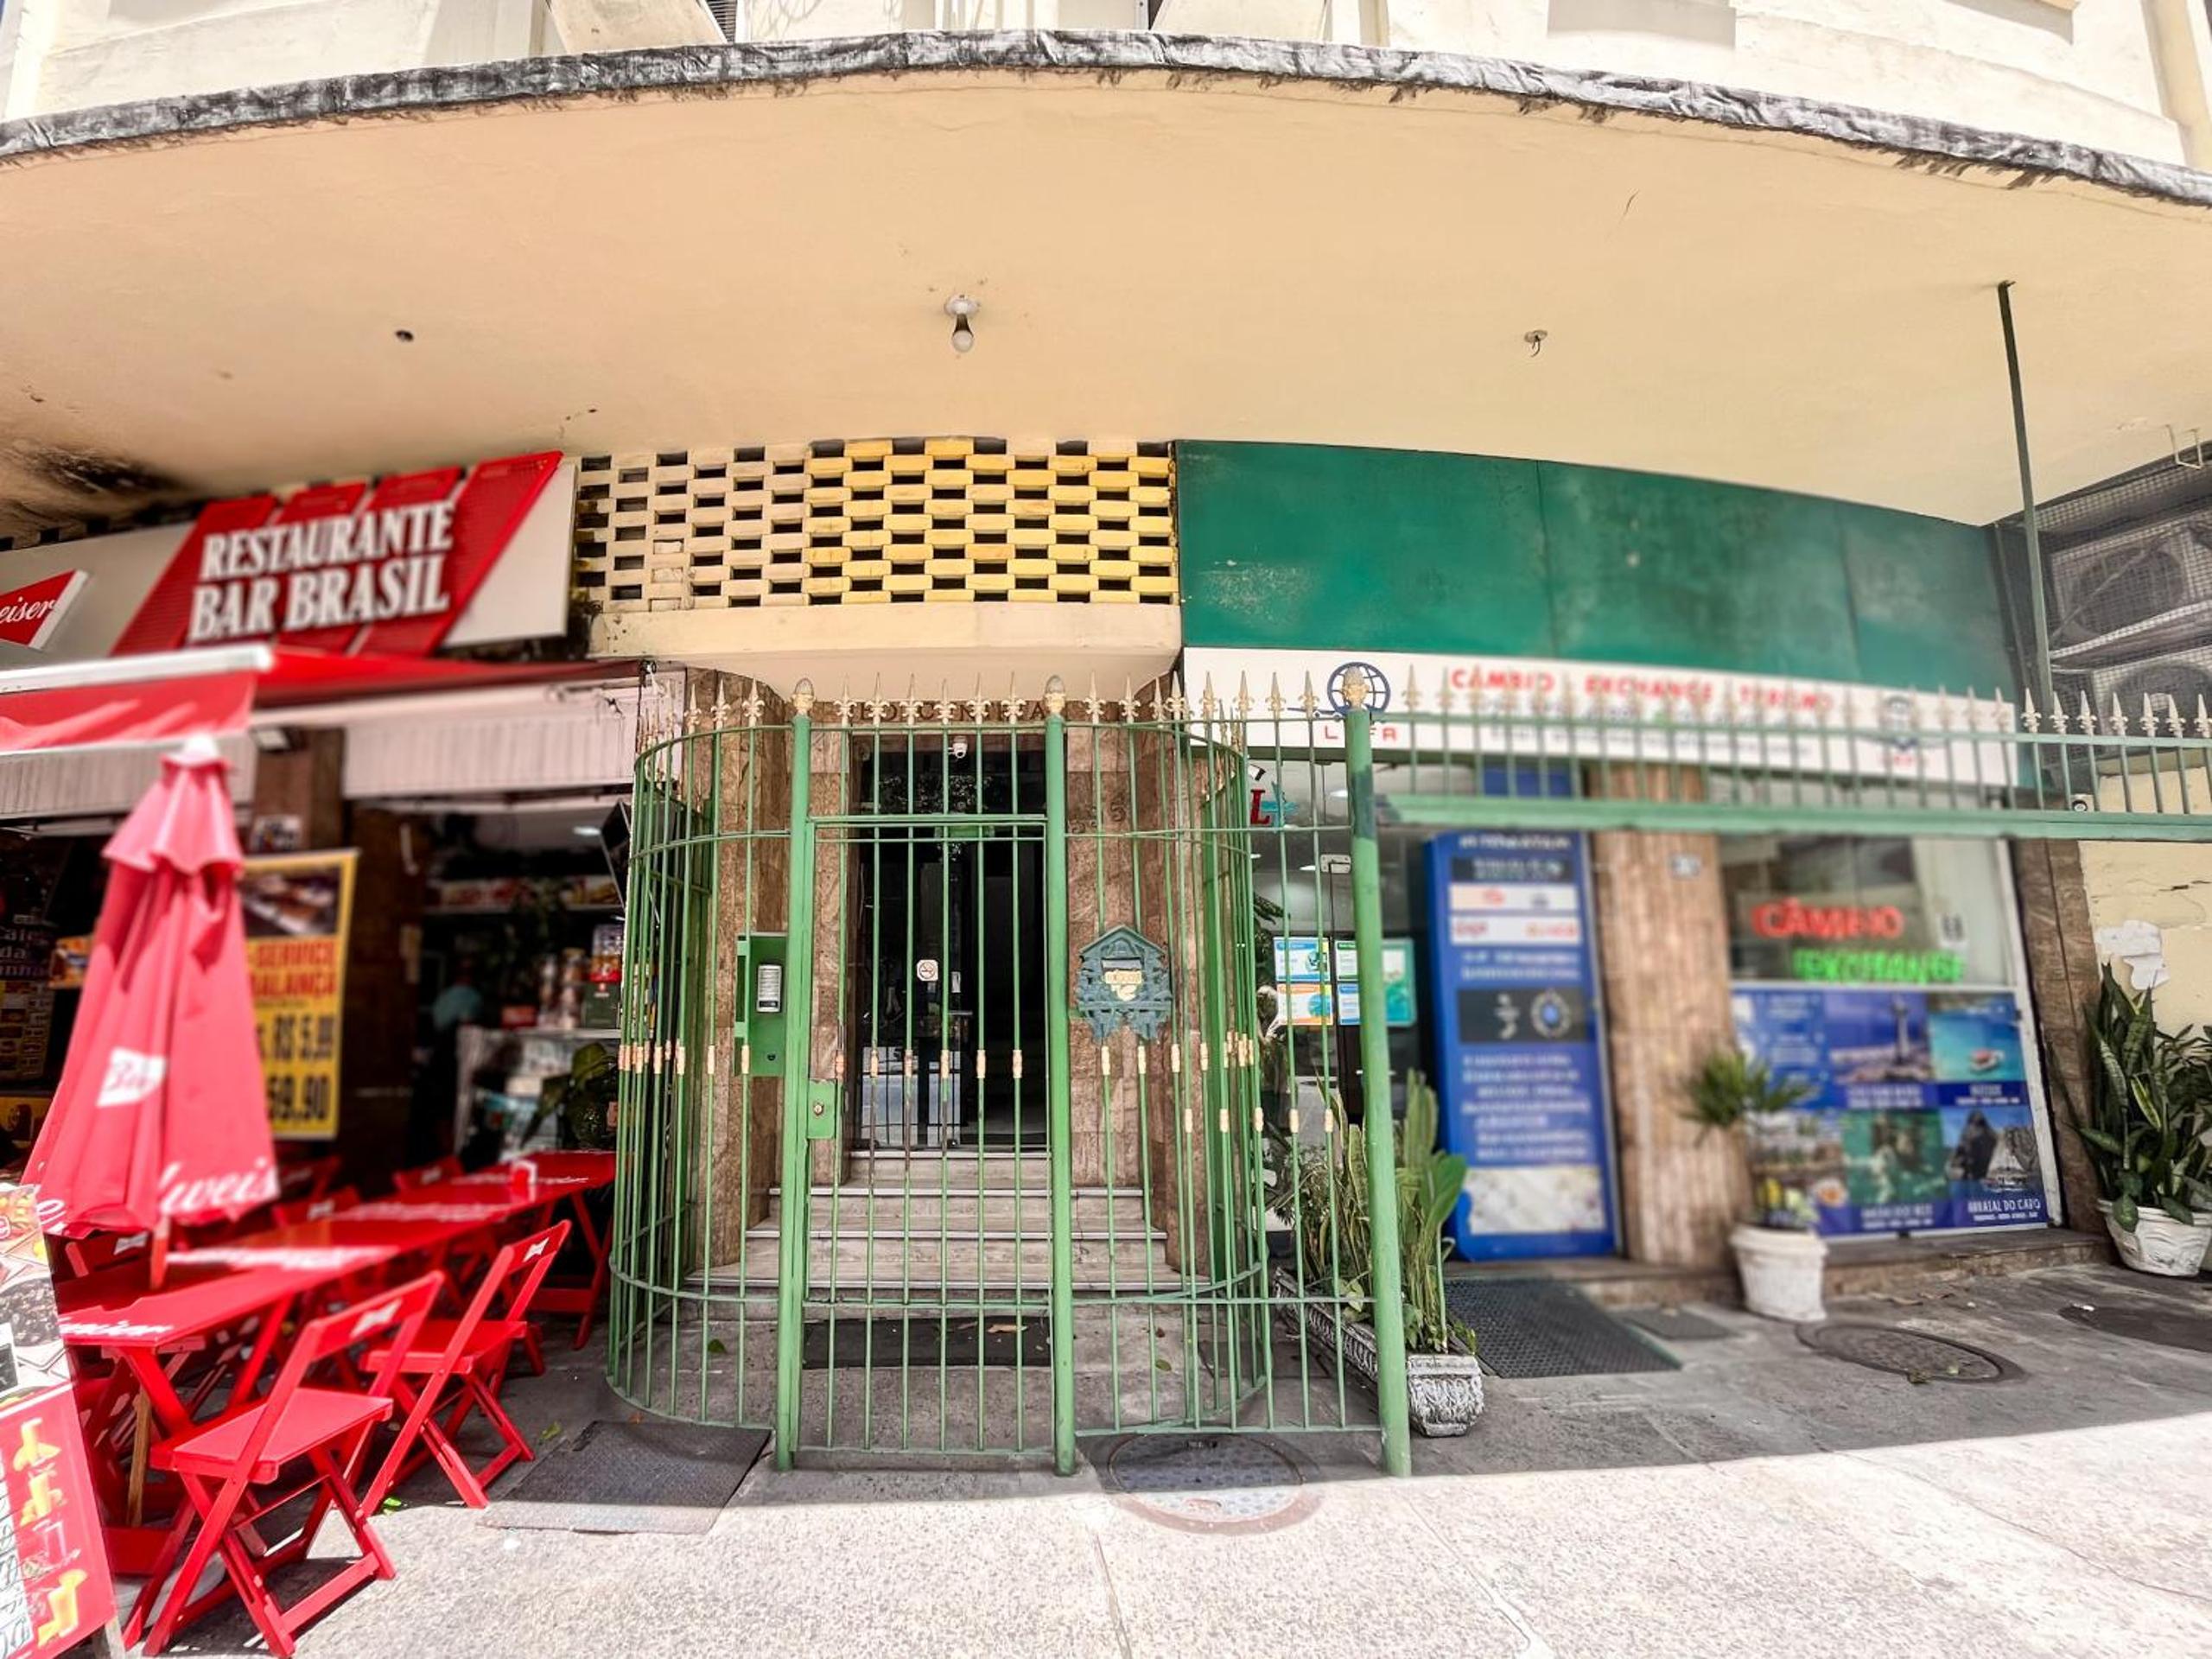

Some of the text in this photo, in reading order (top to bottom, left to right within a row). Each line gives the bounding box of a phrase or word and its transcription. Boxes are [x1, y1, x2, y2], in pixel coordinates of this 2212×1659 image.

[199, 499, 456, 581] RESTAURANTE
[188, 553, 451, 641] BAR BRASIL
